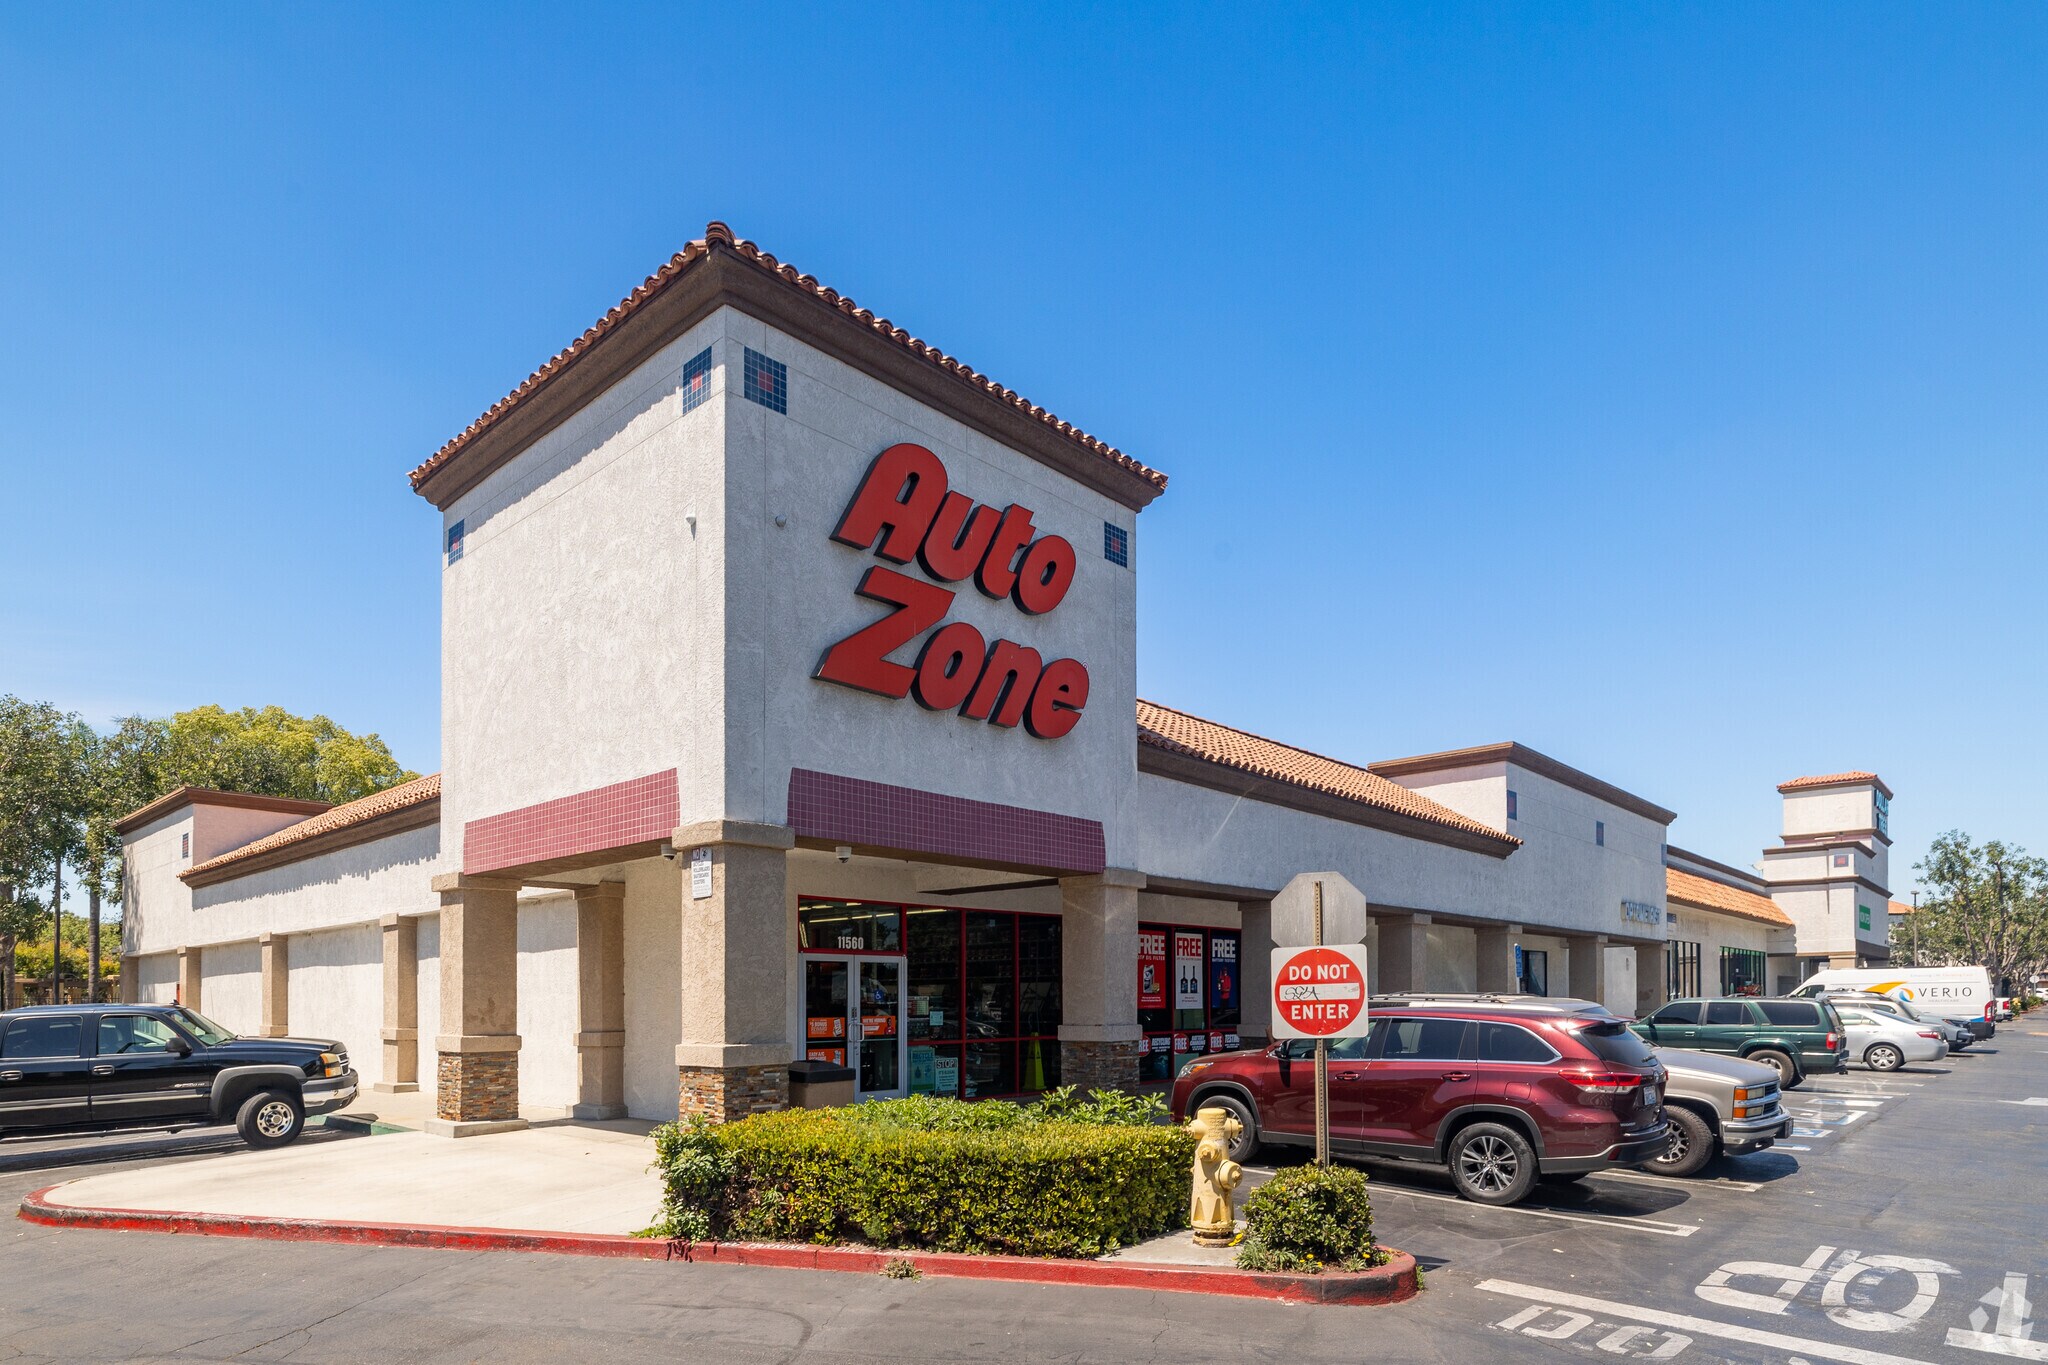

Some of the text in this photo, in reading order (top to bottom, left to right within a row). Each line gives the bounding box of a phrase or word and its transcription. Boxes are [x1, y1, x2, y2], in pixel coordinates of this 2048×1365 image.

[830, 443, 1076, 615] Auto
[810, 565, 1089, 738] Zone
[837, 936, 864, 950] 11560
[1138, 934, 1165, 955] FREE
[1177, 938, 1202, 957] FREE
[1212, 938, 1236, 958] FREE
[1290, 965, 1349, 980] DO NOT
[1918, 987, 1972, 998] VERIO
[1292, 1005, 1348, 1019] ENTER
[1138, 1040, 1150, 1052] REE
[1174, 1037, 1188, 1050] FREE
[1210, 1036, 1223, 1048] FREE
[1694, 1245, 2048, 1363] TOP
